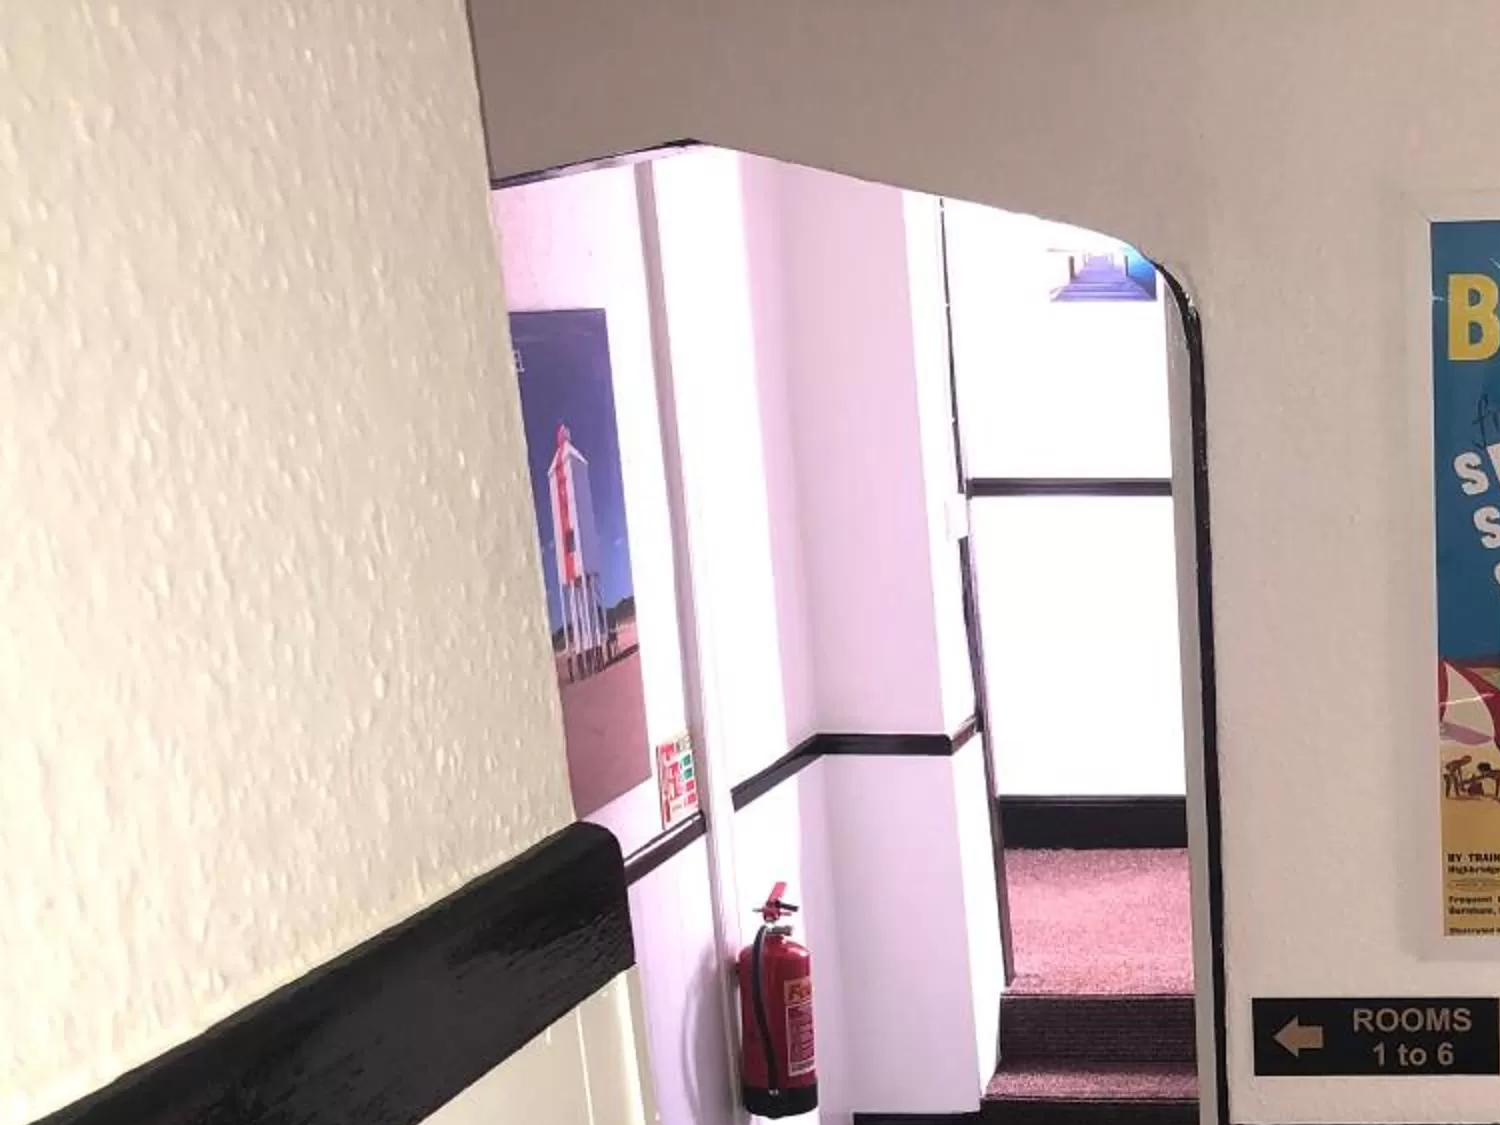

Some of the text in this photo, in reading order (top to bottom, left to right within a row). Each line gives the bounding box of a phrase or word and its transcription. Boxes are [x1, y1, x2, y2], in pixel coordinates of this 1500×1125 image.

[1447, 853, 1463, 863] BY
[1468, 853, 1500, 863] TRAIN
[1352, 1007, 1473, 1033] ROOMS
[1372, 1041, 1455, 1067] 1 to 6
